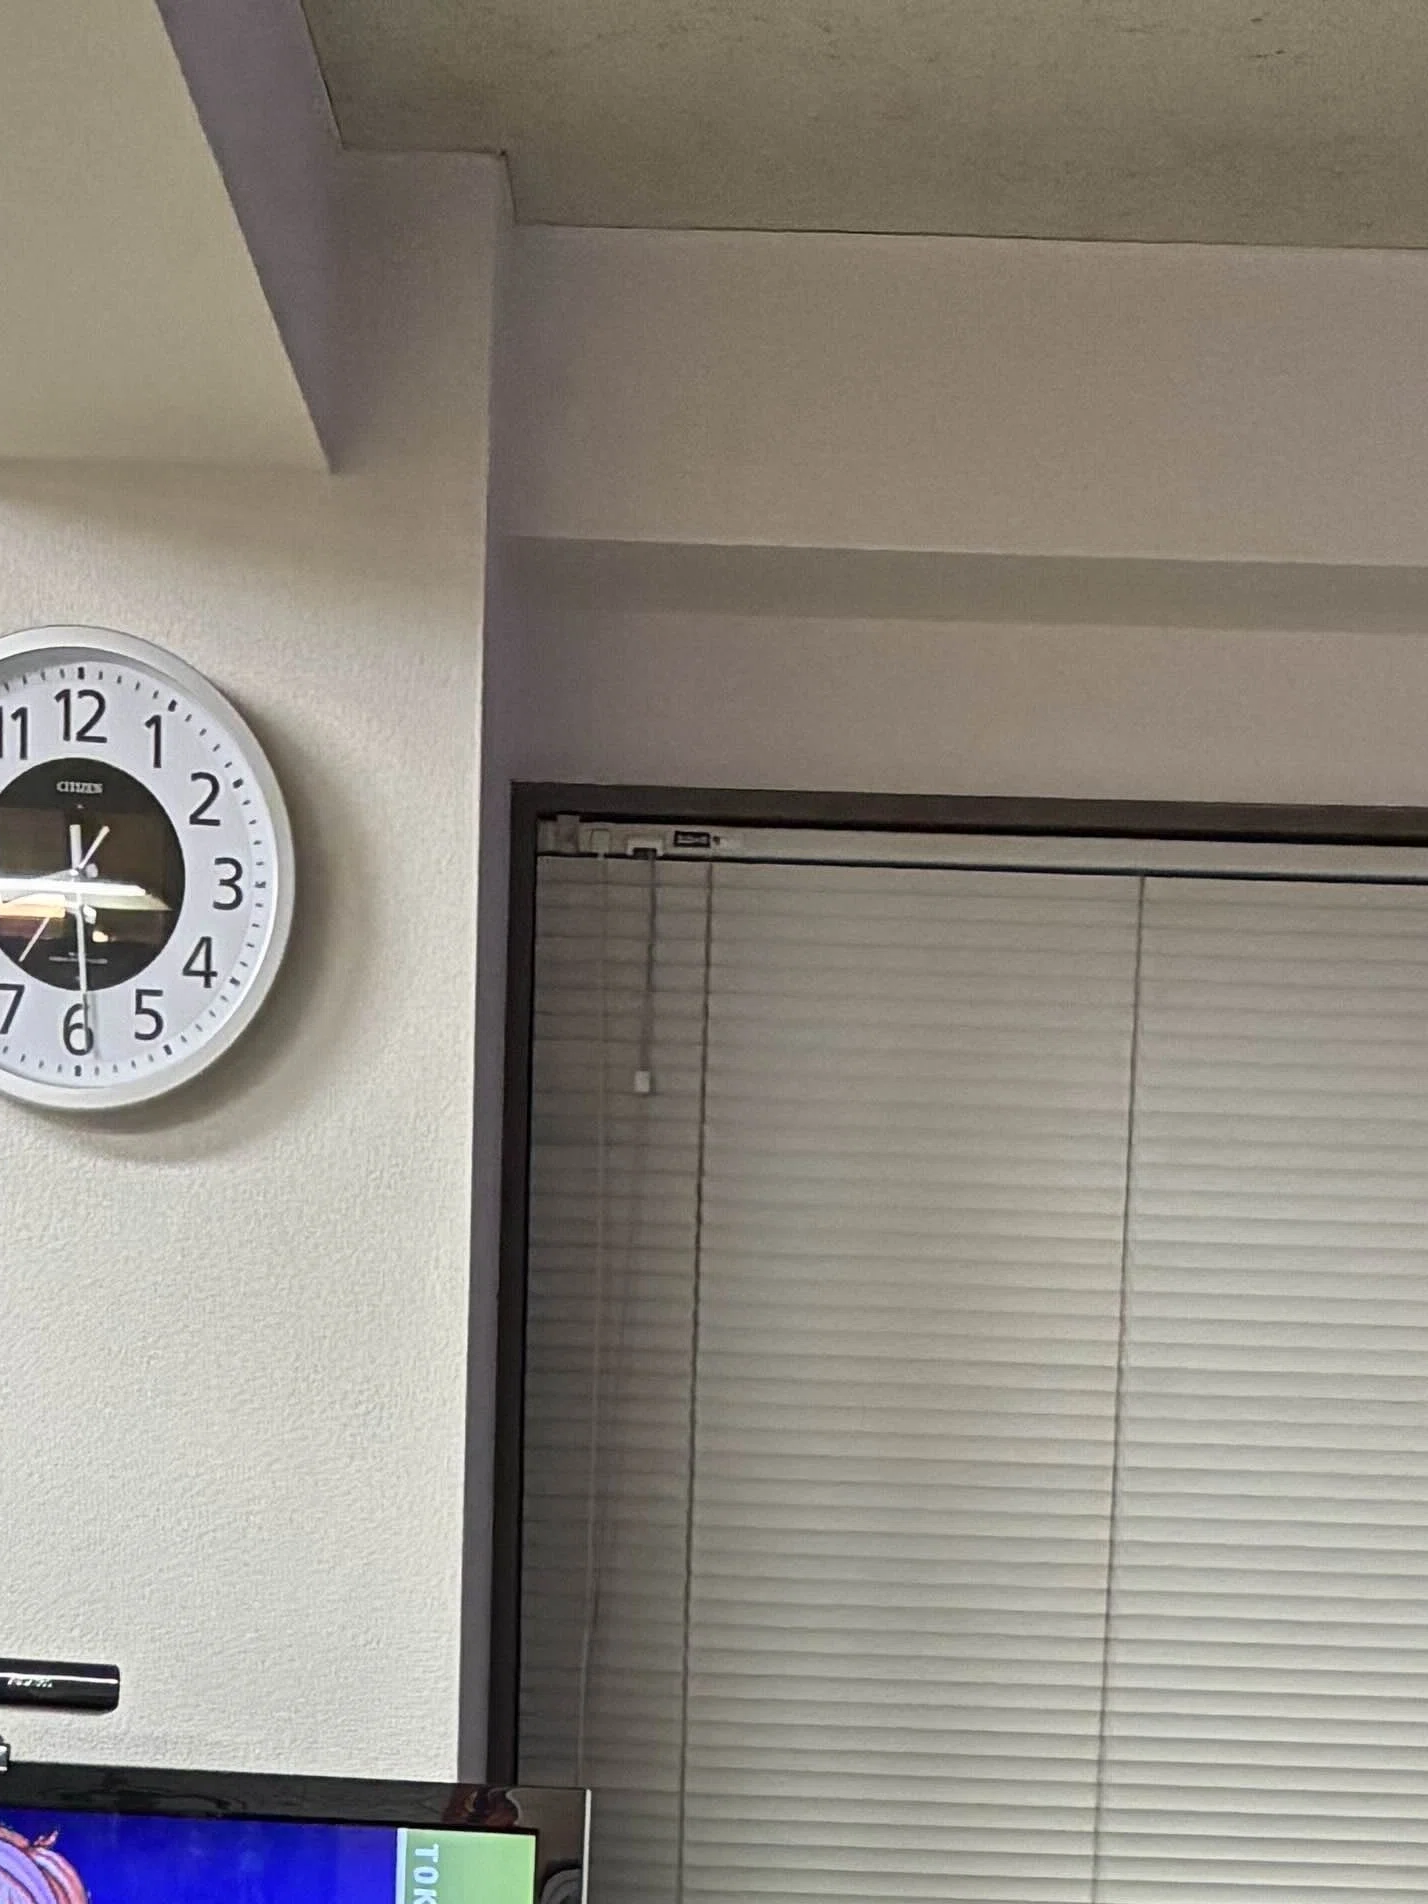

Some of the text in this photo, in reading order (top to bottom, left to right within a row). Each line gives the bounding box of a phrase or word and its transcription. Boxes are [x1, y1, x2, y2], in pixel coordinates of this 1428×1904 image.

[55, 689, 107, 744] 12
[145, 715, 162, 768] 1
[56, 781, 103, 794] CITIZEN
[189, 772, 221, 826] 2
[213, 857, 243, 911] 3
[182, 936, 217, 989] 4
[64, 1004, 94, 1056] 6
[134, 989, 164, 1041] 5
